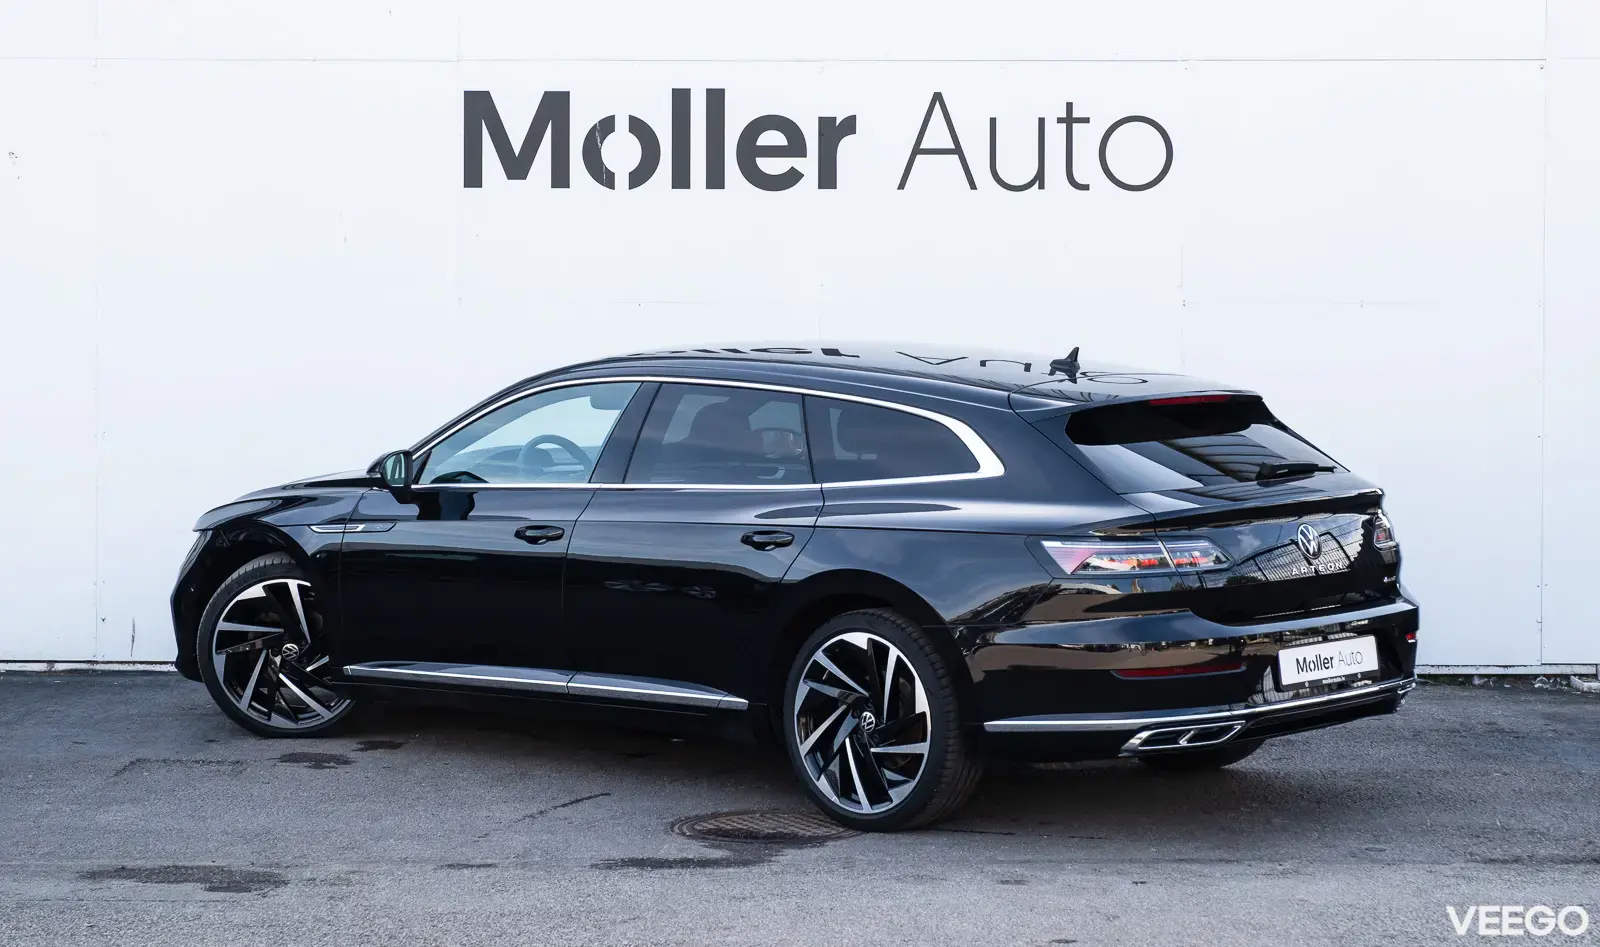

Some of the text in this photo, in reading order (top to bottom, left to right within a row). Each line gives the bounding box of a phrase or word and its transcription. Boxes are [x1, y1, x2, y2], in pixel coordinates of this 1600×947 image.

[463, 87, 1174, 192] Moller Auto
[1291, 562, 1344, 576] ARTEON
[1296, 650, 1364, 675] Moller Auto
